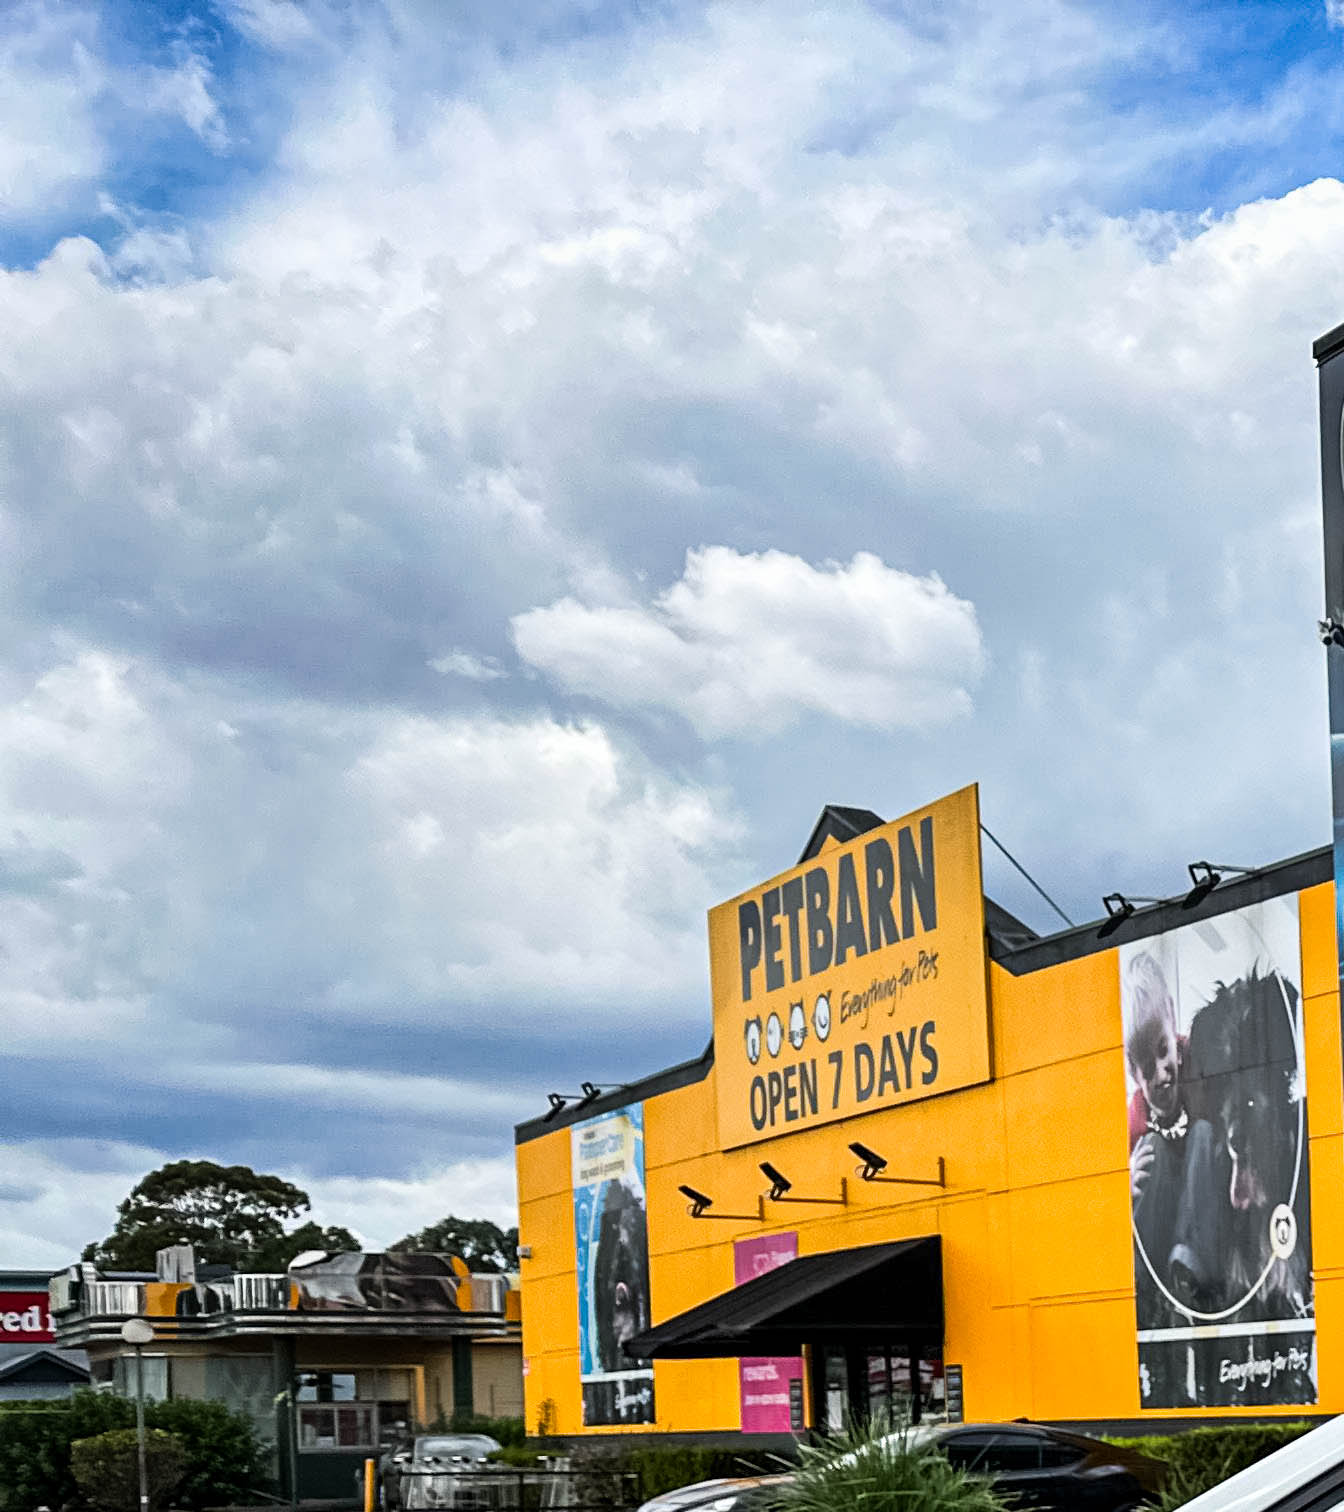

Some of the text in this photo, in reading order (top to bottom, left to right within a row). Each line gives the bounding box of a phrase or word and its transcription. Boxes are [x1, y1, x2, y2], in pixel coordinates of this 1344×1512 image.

[739, 816, 937, 1002] PETBARN
[749, 1020, 939, 1131] OPEN 7 DAYS
